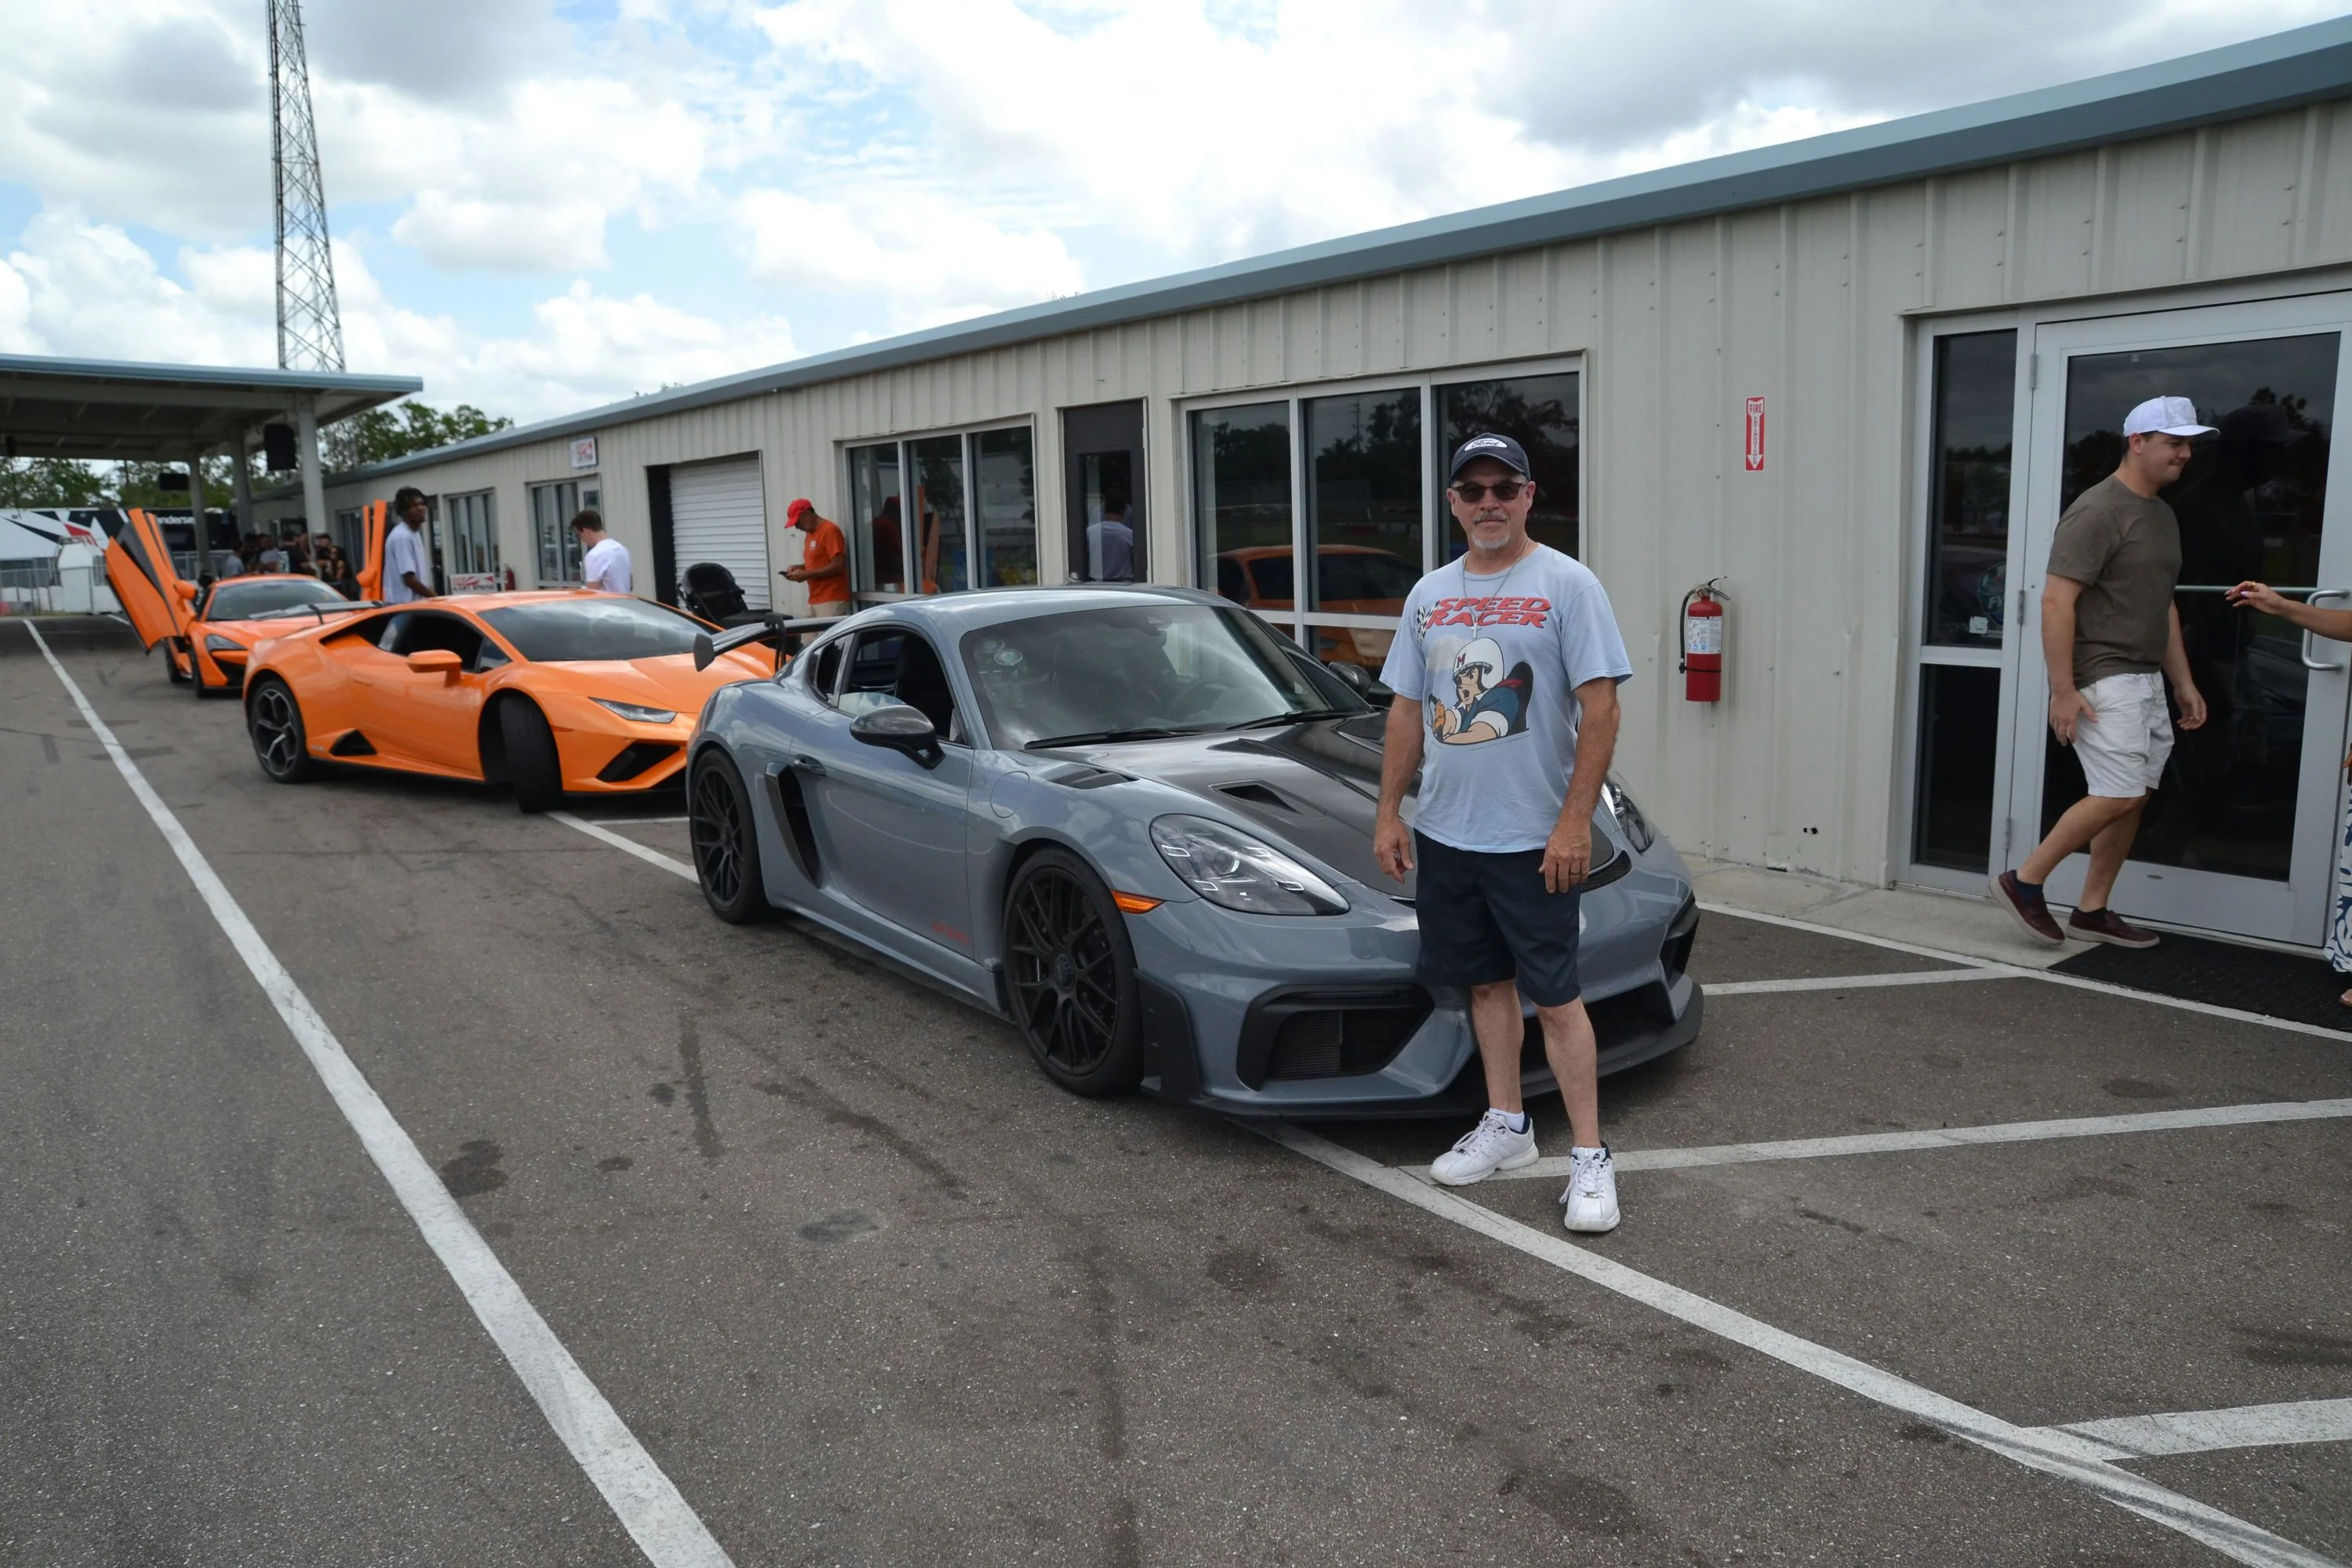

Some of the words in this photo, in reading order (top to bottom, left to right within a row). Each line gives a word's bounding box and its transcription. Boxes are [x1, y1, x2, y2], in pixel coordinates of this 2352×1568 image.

[1750, 404, 1762, 414] FIRE
[158, 515, 195, 524] nderse
[1438, 597, 1552, 612] SPEED
[1425, 611, 1548, 629] RACER
[1457, 652, 1466, 668] M
